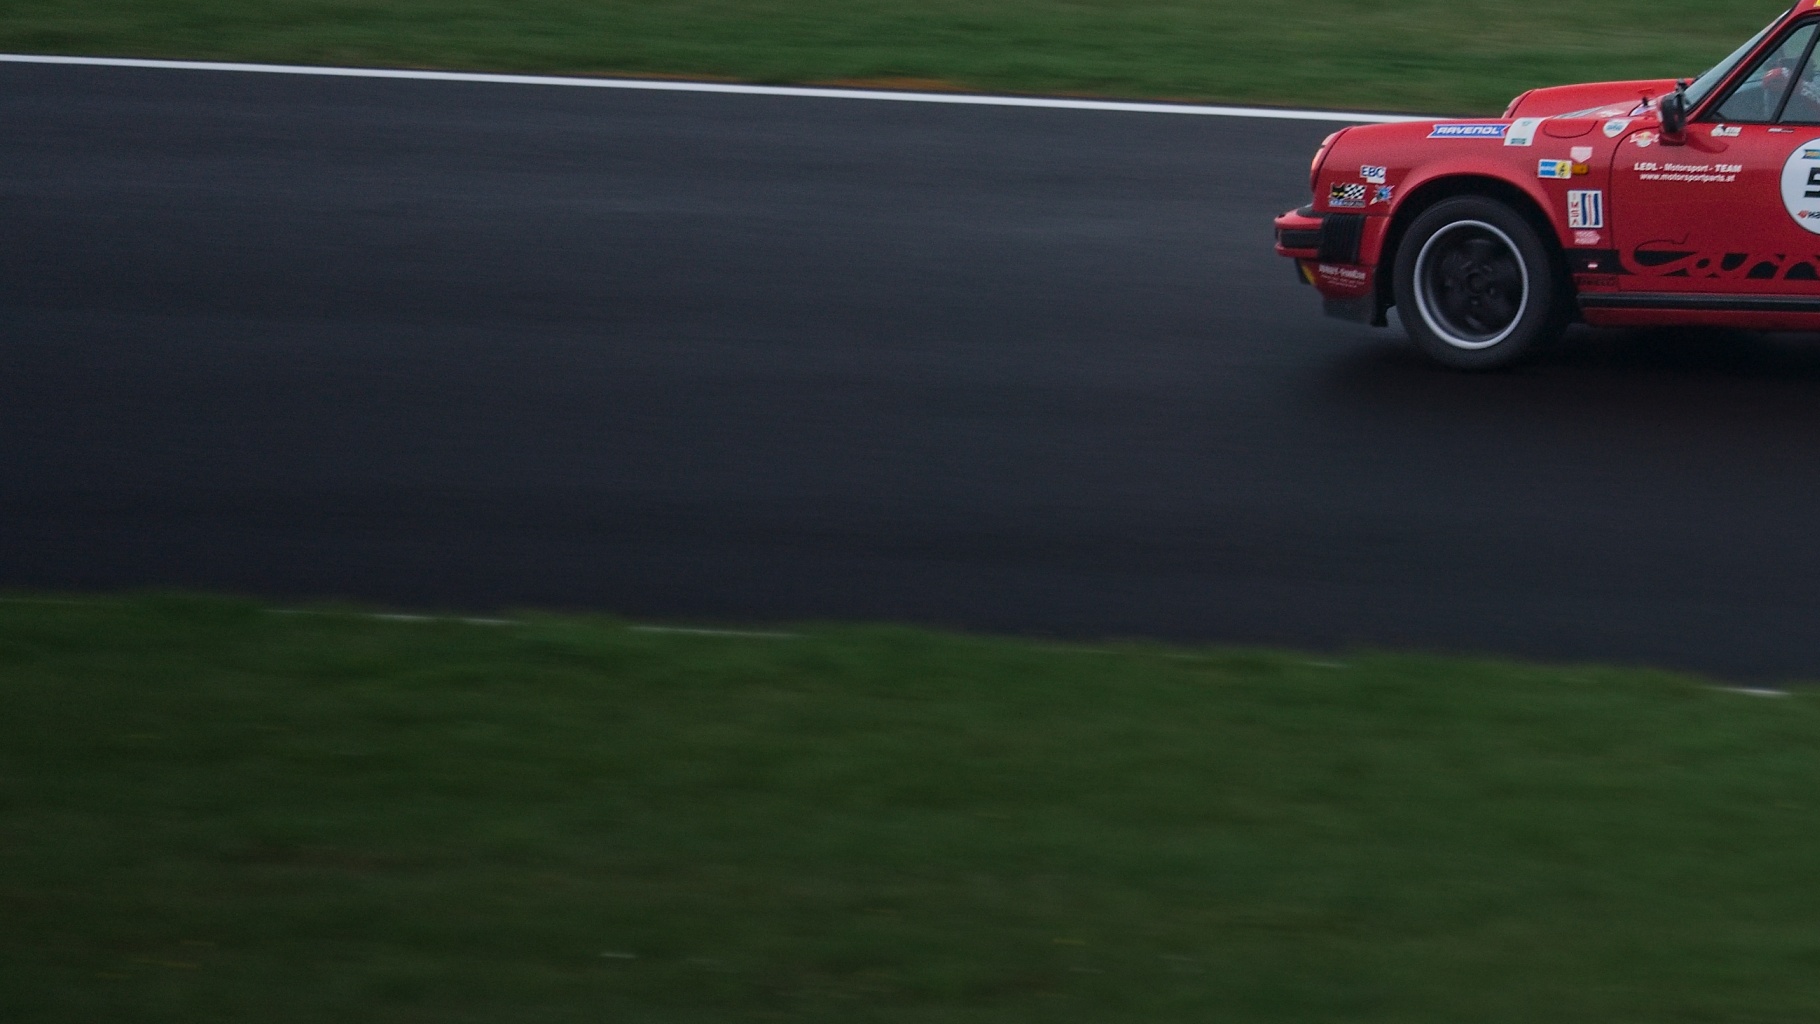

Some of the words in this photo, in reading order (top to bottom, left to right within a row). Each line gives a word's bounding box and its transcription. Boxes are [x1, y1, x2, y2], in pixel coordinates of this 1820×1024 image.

[1437, 126, 1500, 136] RAVENOL
[1361, 166, 1385, 178] EBC
[1634, 162, 1658, 171] LEDL
[1664, 163, 1708, 173] Motorsport
[1714, 163, 1743, 173] TEAM
